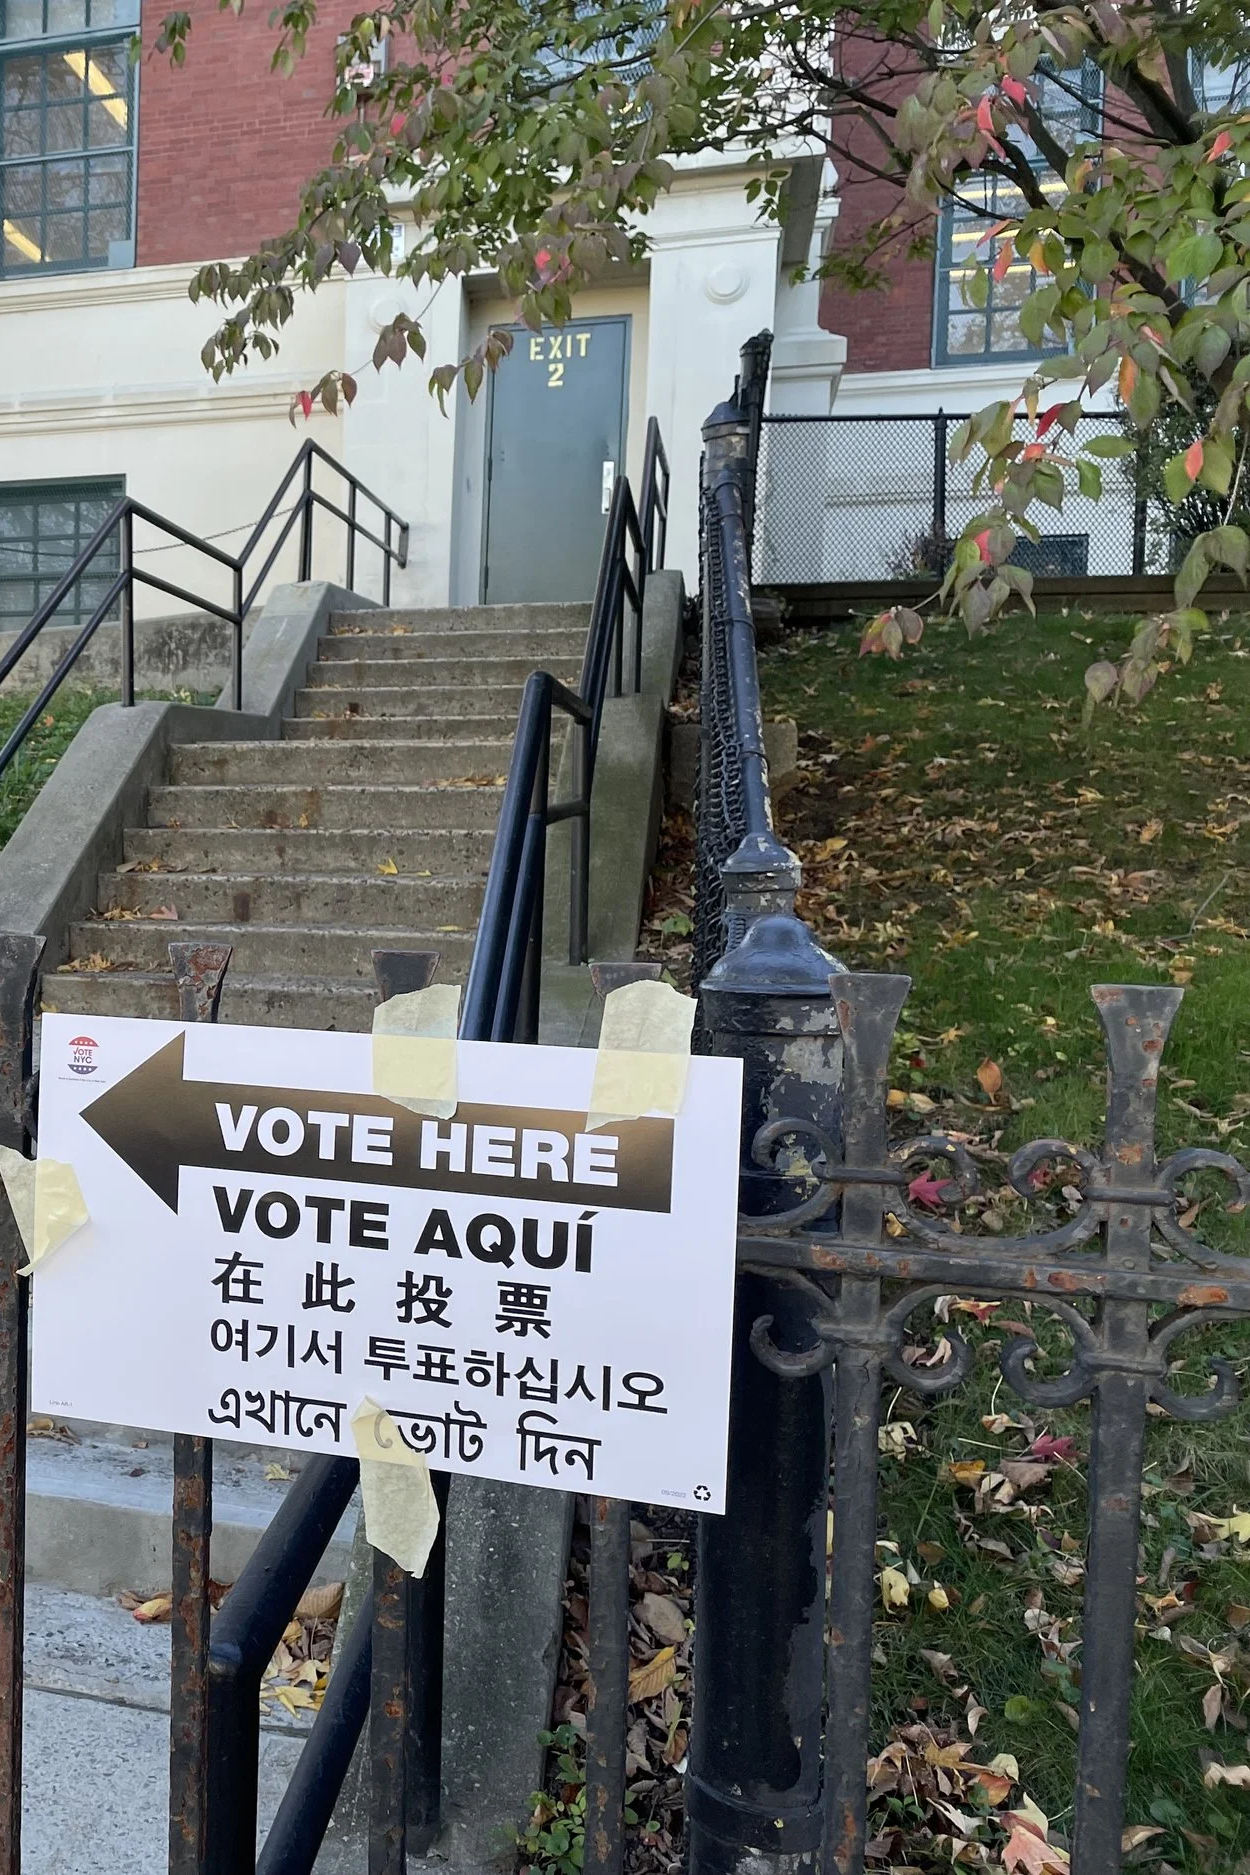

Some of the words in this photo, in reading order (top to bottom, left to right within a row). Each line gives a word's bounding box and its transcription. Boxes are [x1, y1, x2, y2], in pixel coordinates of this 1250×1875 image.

[530, 333, 591, 361] EXIT
[548, 363, 565, 387] 2
[73, 1056, 93, 1064] NYC
[214, 1102, 394, 1166] VOTE
[419, 1119, 620, 1188] HERE
[212, 1185, 390, 1251] VOTE
[413, 1207, 600, 1273] AQUÍ
[211, 1251, 551, 1339] 在此投票
[209, 1318, 343, 1375] 여기서
[363, 1335, 669, 1415] 투표하십시오
[207, 1387, 348, 1443] এখানে
[515, 1409, 602, 1481] দিন
